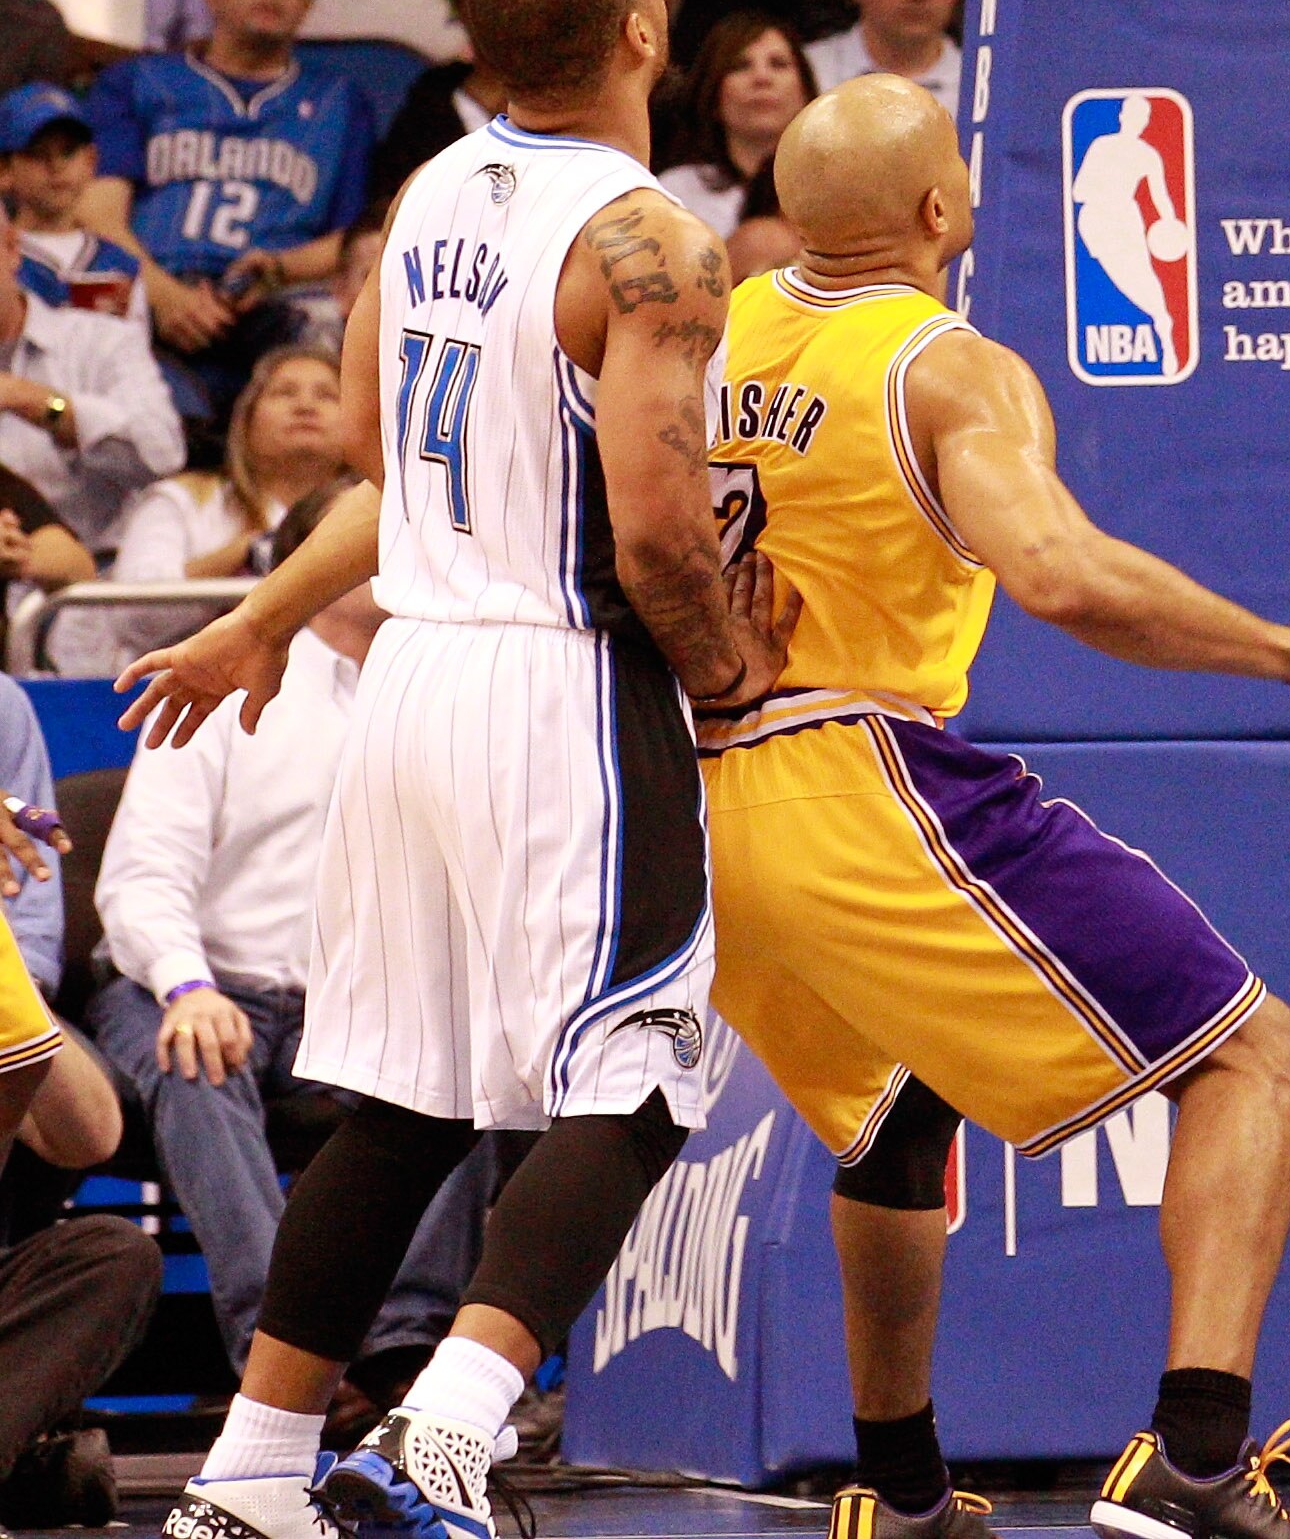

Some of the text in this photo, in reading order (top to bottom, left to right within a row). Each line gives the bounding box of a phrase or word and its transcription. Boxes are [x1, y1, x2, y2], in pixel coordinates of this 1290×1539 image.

[147, 129, 319, 205] ORLANDO
[182, 180, 259, 249] 12
[1086, 324, 1158, 363] NBA
[396, 328, 480, 536] 14
[719, 380, 827, 456] ISHER
